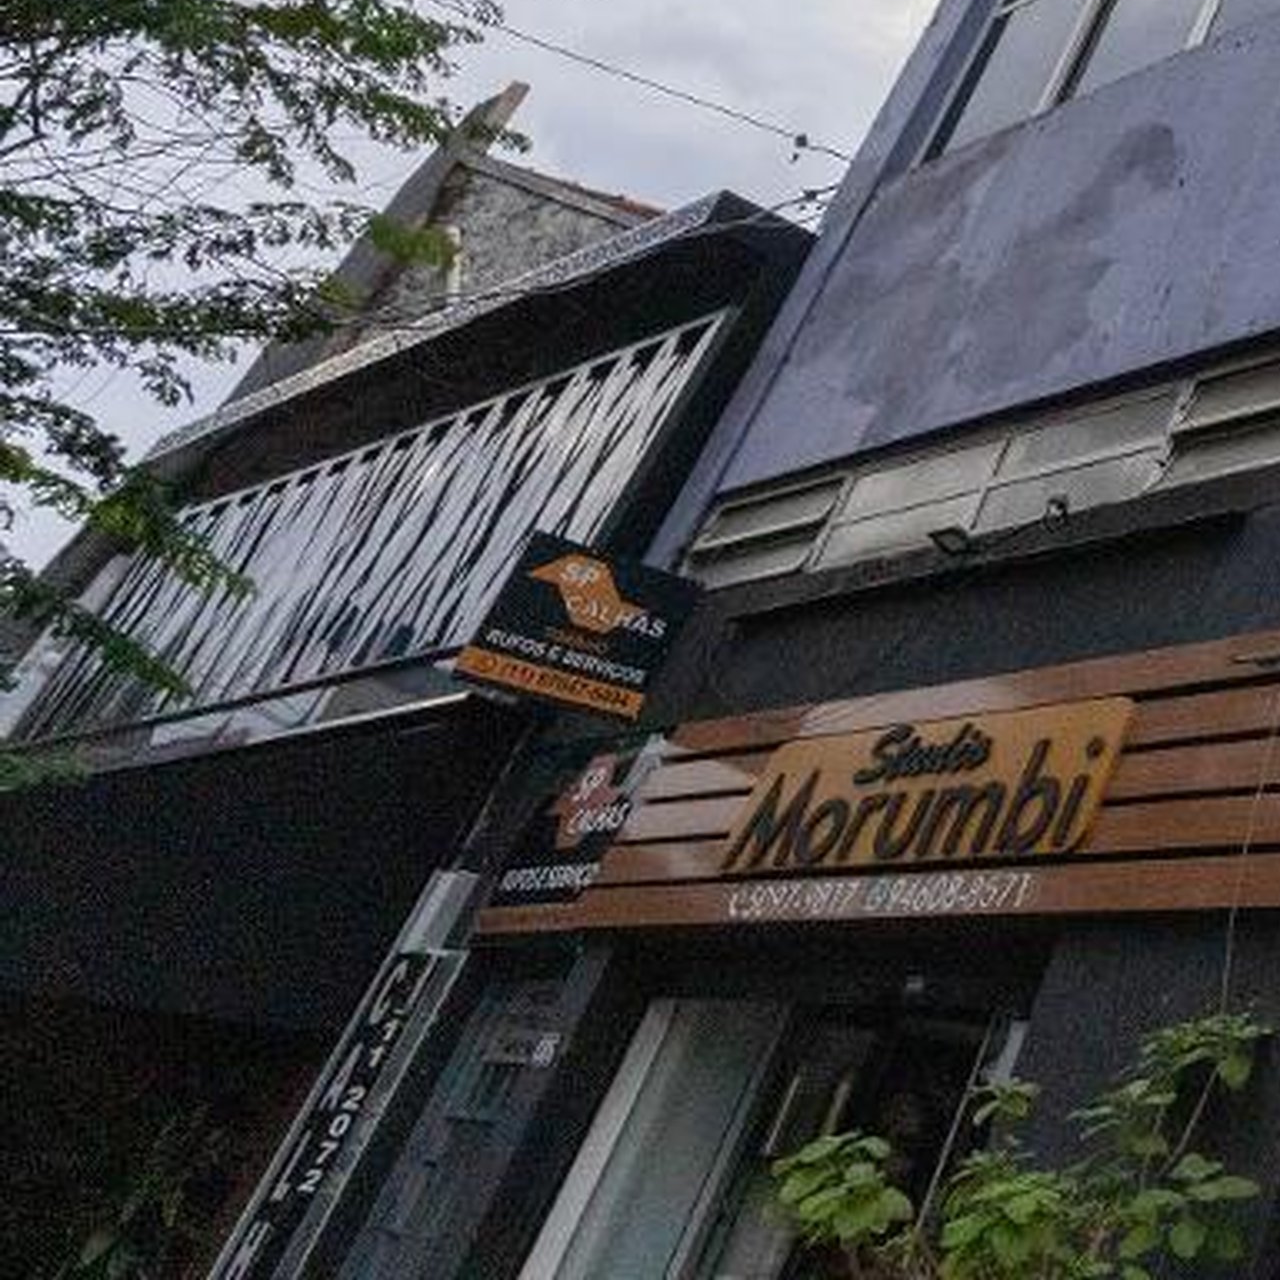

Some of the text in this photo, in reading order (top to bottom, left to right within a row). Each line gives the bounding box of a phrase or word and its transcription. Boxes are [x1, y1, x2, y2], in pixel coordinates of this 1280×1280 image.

[560, 561, 602, 587] SP
[566, 593, 667, 639] CALHAS
[485, 628, 546, 658] RUFOS
[854, 721, 993, 786] Studio
[719, 735, 1106, 870] Morumbi
